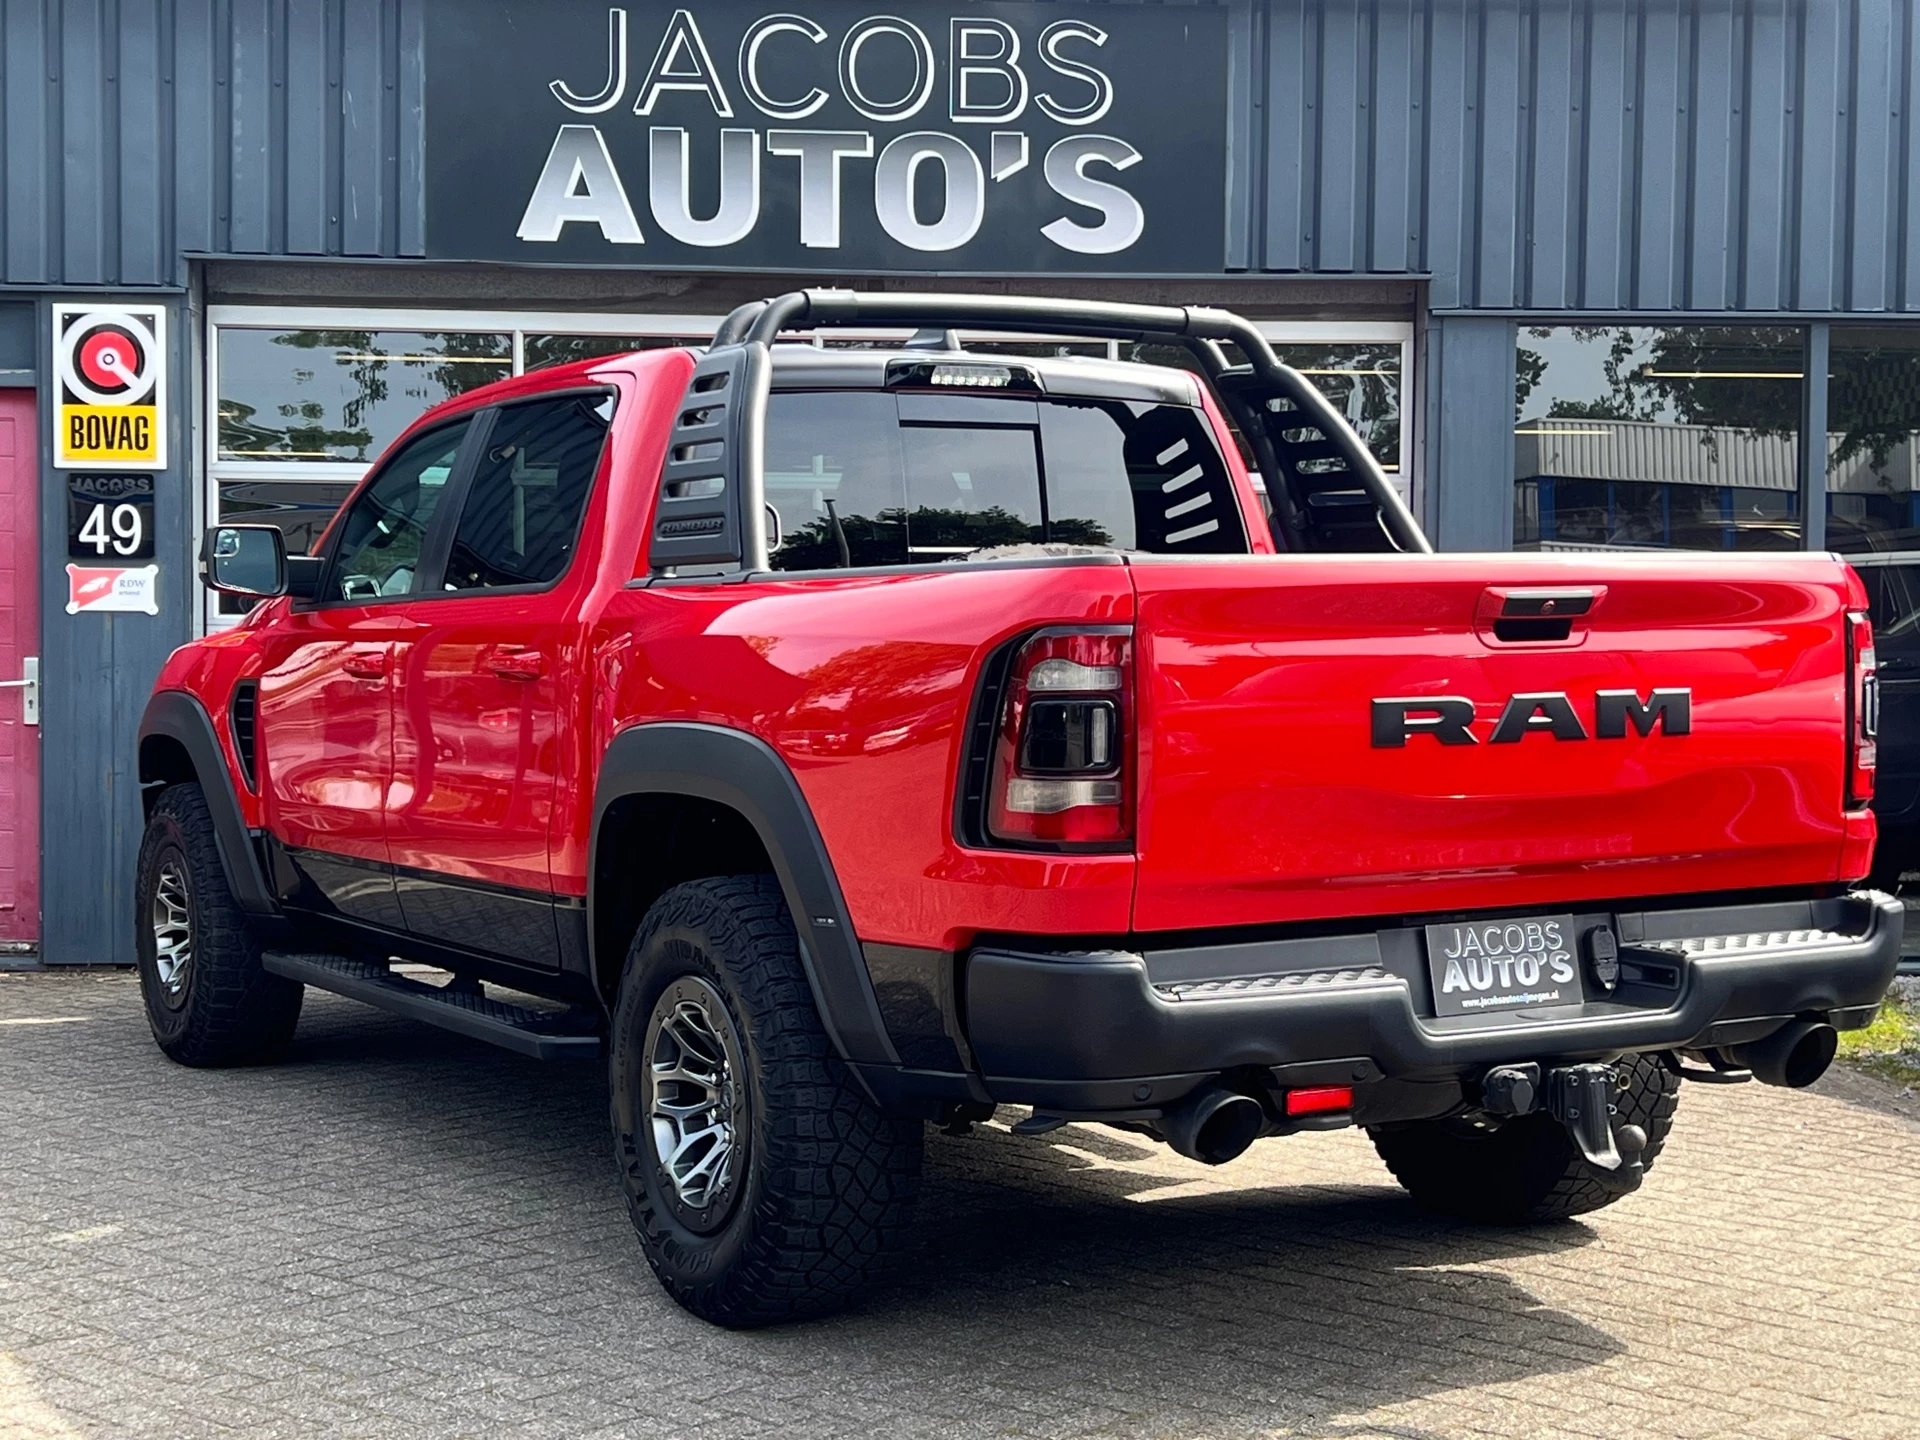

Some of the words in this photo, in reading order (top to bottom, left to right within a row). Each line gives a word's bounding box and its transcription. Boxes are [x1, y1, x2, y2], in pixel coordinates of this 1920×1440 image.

[548, 8, 1114, 126] JACOBS
[516, 124, 1145, 255] AUTO'S
[70, 415, 149, 451] BOVAG
[69, 477, 150, 492] JACOBS
[78, 503, 142, 555] 49
[119, 579, 146, 588] RDW
[1370, 687, 1692, 748] RAM
[1444, 921, 1563, 958] JACOBS
[1442, 950, 1574, 993] AUTO'S
